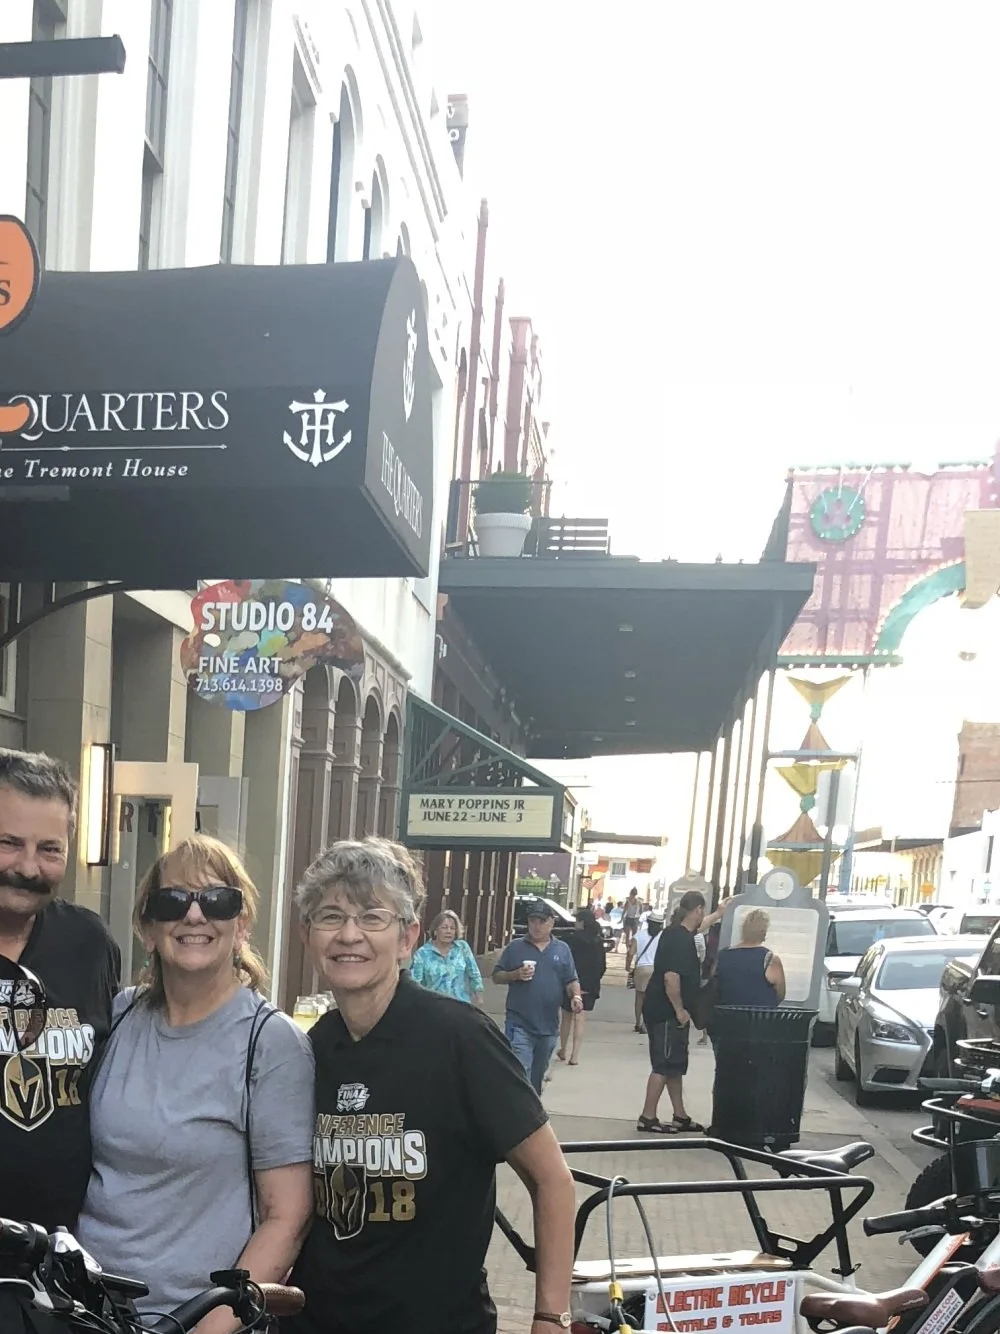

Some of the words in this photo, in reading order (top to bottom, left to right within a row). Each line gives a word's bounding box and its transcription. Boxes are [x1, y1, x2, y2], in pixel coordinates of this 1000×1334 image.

[11, 390, 230, 441] QUARTERS
[24, 460, 113, 479] Tremont
[123, 459, 189, 478] House
[200, 601, 295, 634] STUDIO
[301, 603, 333, 634] 84
[199, 656, 238, 675] FINE
[244, 656, 282, 675] ART
[196, 676, 283, 694] 713.614.1398
[420, 799, 456, 809] MARY
[458, 799, 510, 810] POPPINS
[513, 800, 525, 810] JR
[422, 811, 451, 822] JUNE
[453, 811, 467, 821] 22
[478, 811, 507, 822] JUNE
[516, 812, 523, 822] 3
[656, 1287, 723, 1314] ELECTRIC
[728, 1280, 786, 1306] BICYCLE
[722, 1315, 733, 1328] &
[739, 1310, 782, 1326] TOURS
